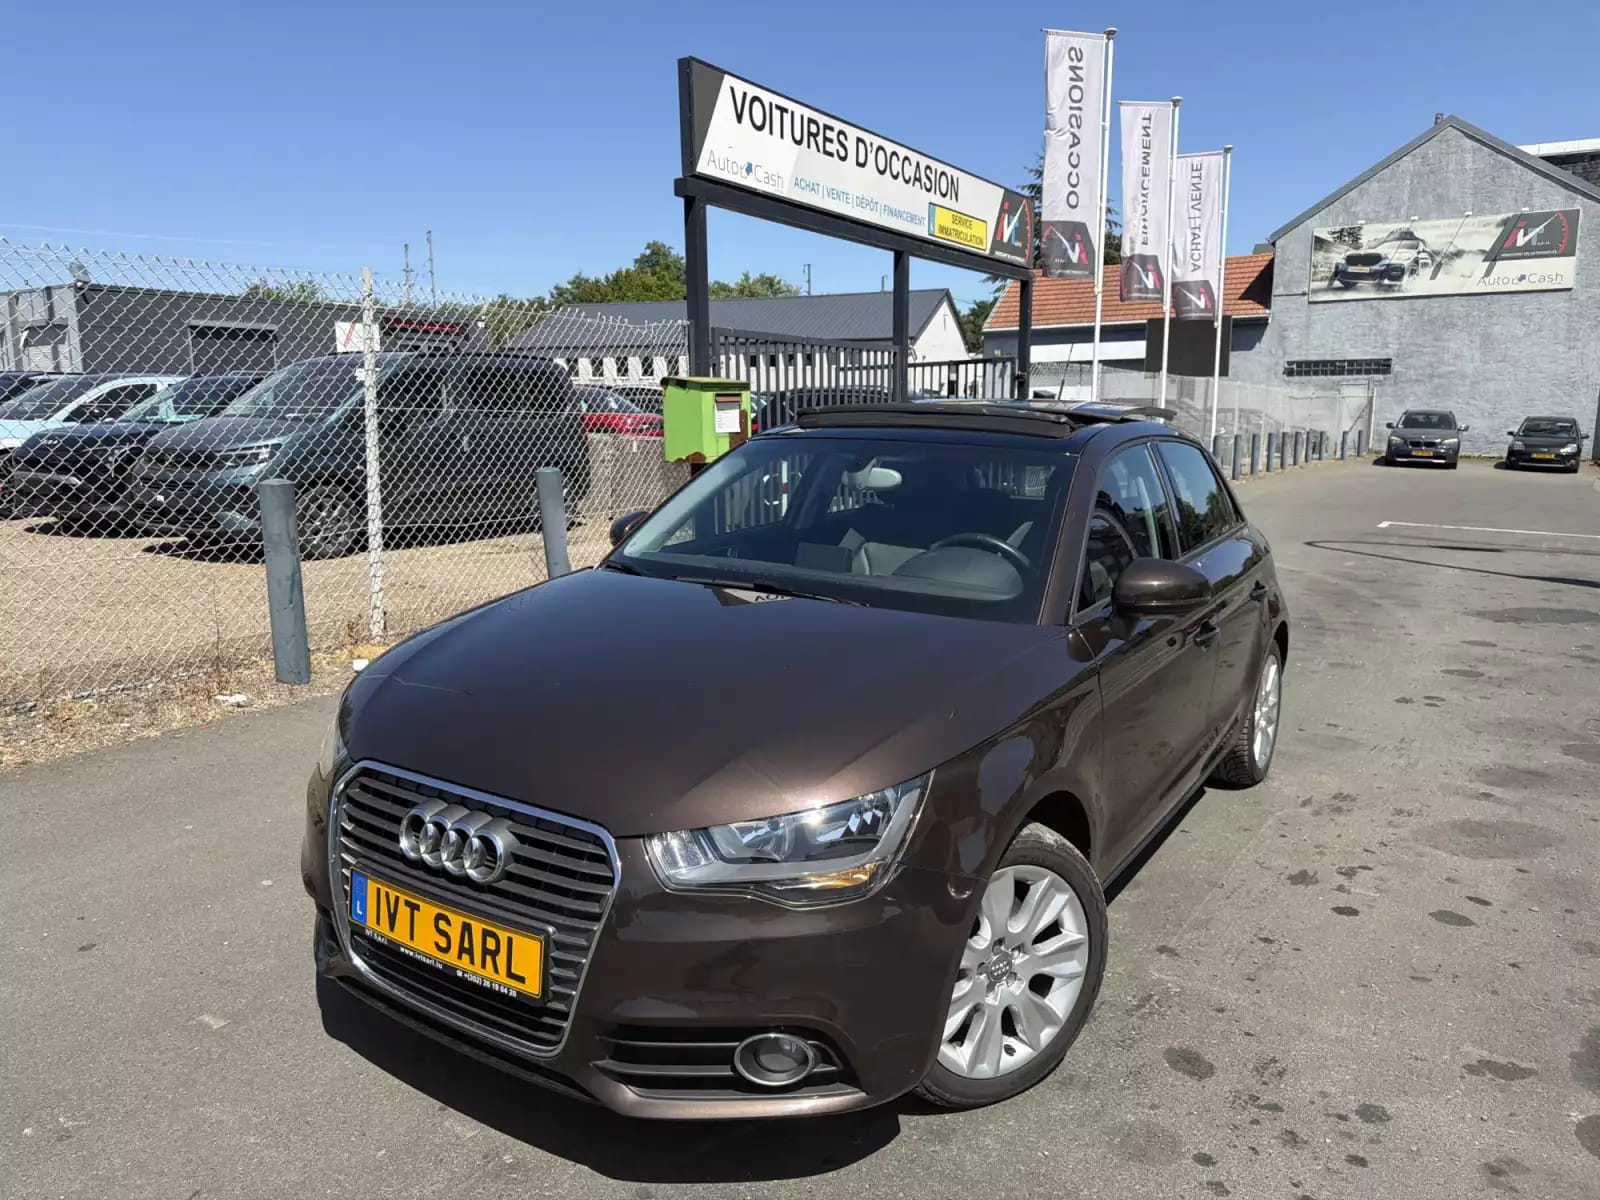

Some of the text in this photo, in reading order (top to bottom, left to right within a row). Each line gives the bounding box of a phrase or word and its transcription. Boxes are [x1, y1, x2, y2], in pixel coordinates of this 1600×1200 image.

[730, 86, 960, 203] VOITURES D'OCCASION
[794, 176, 926, 227] ACHAT VENTE DÉPÔT FINANCEMENT
[938, 224, 984, 247] IMMATRICULATION
[951, 214, 973, 229] SERVICE
[356, 900, 363, 915] L
[376, 887, 526, 984] IVT SARL
